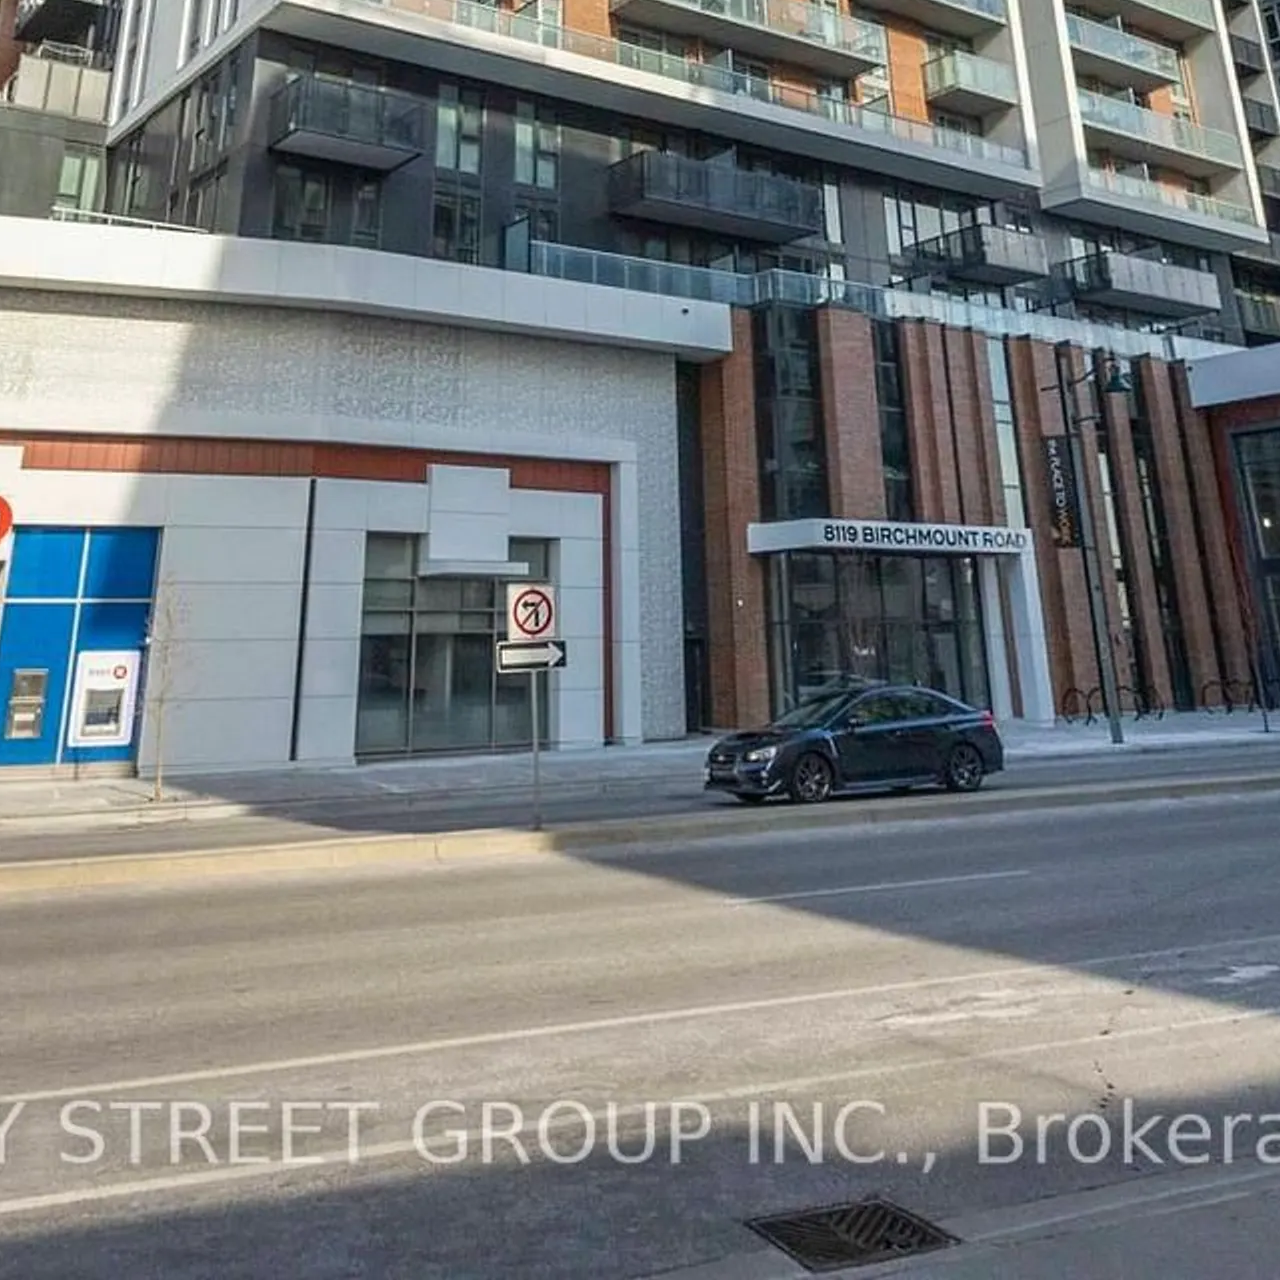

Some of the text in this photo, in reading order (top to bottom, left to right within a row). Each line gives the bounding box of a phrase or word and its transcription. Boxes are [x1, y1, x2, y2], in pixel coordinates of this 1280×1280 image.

[823, 524, 1027, 549] 8119 BIRCHMOUNT ROAD
